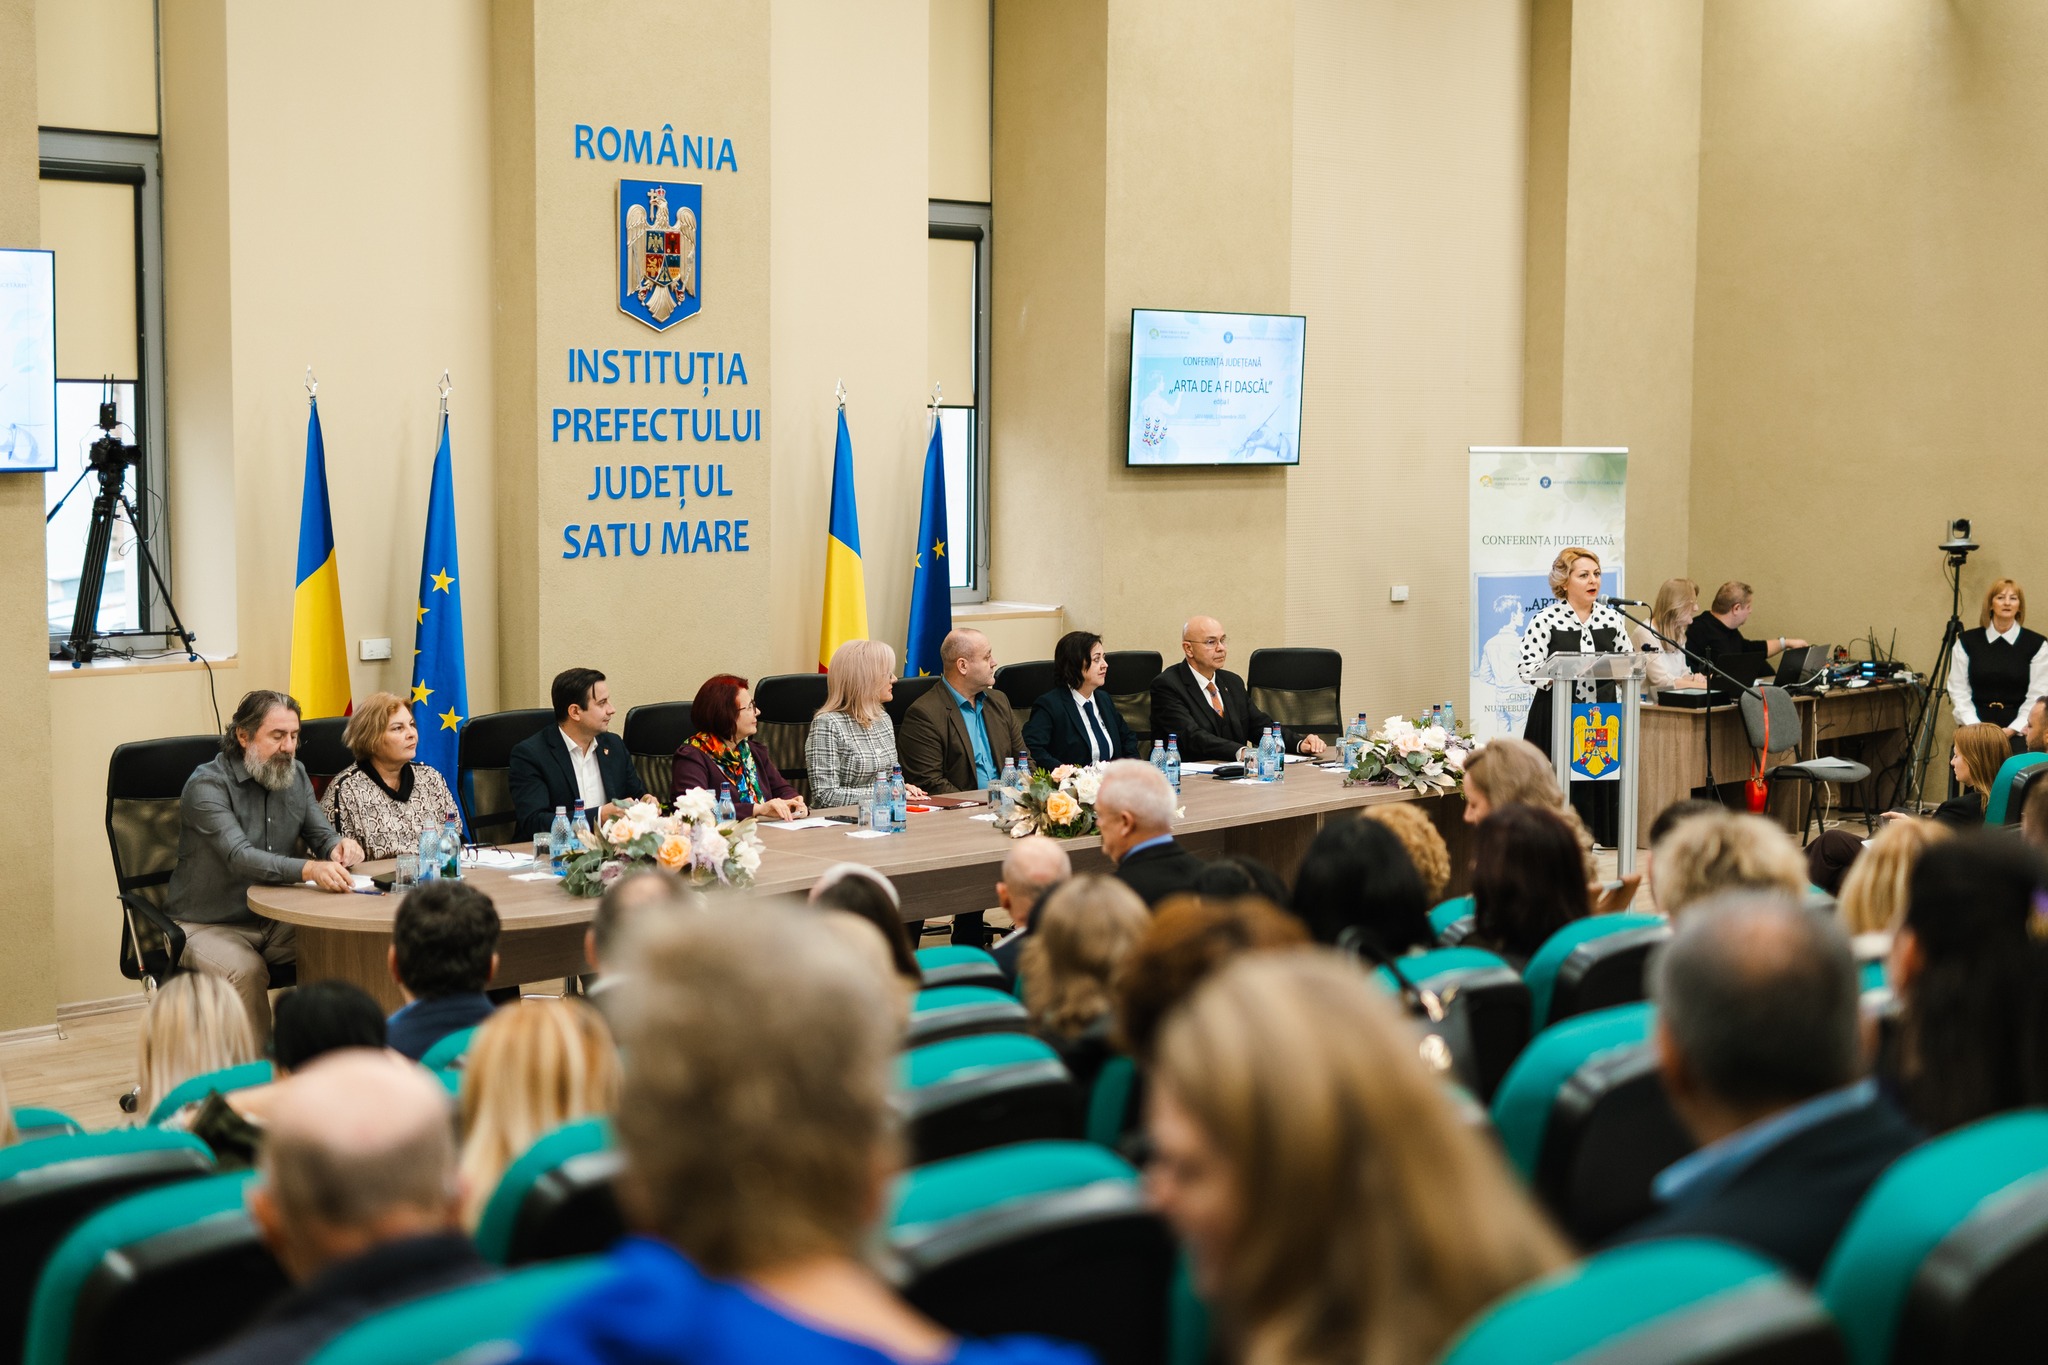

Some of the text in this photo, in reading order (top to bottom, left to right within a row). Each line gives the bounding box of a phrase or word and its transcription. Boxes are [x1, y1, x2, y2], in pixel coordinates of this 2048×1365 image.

[575, 123, 738, 172] ROMÂNIA
[568, 348, 748, 397] INSTITUȚIA
[1200, 380, 1213, 393] DE
[1215, 380, 1223, 393] A
[1224, 381, 1232, 393] FI
[552, 408, 761, 442] PREFECTULUI
[588, 464, 733, 510] JUDEȚUL
[562, 519, 750, 559] SATU MARE
[1482, 534, 1615, 547] CONFERINȚA JUDEȚEANĂ
[1484, 704, 1497, 712] NU
